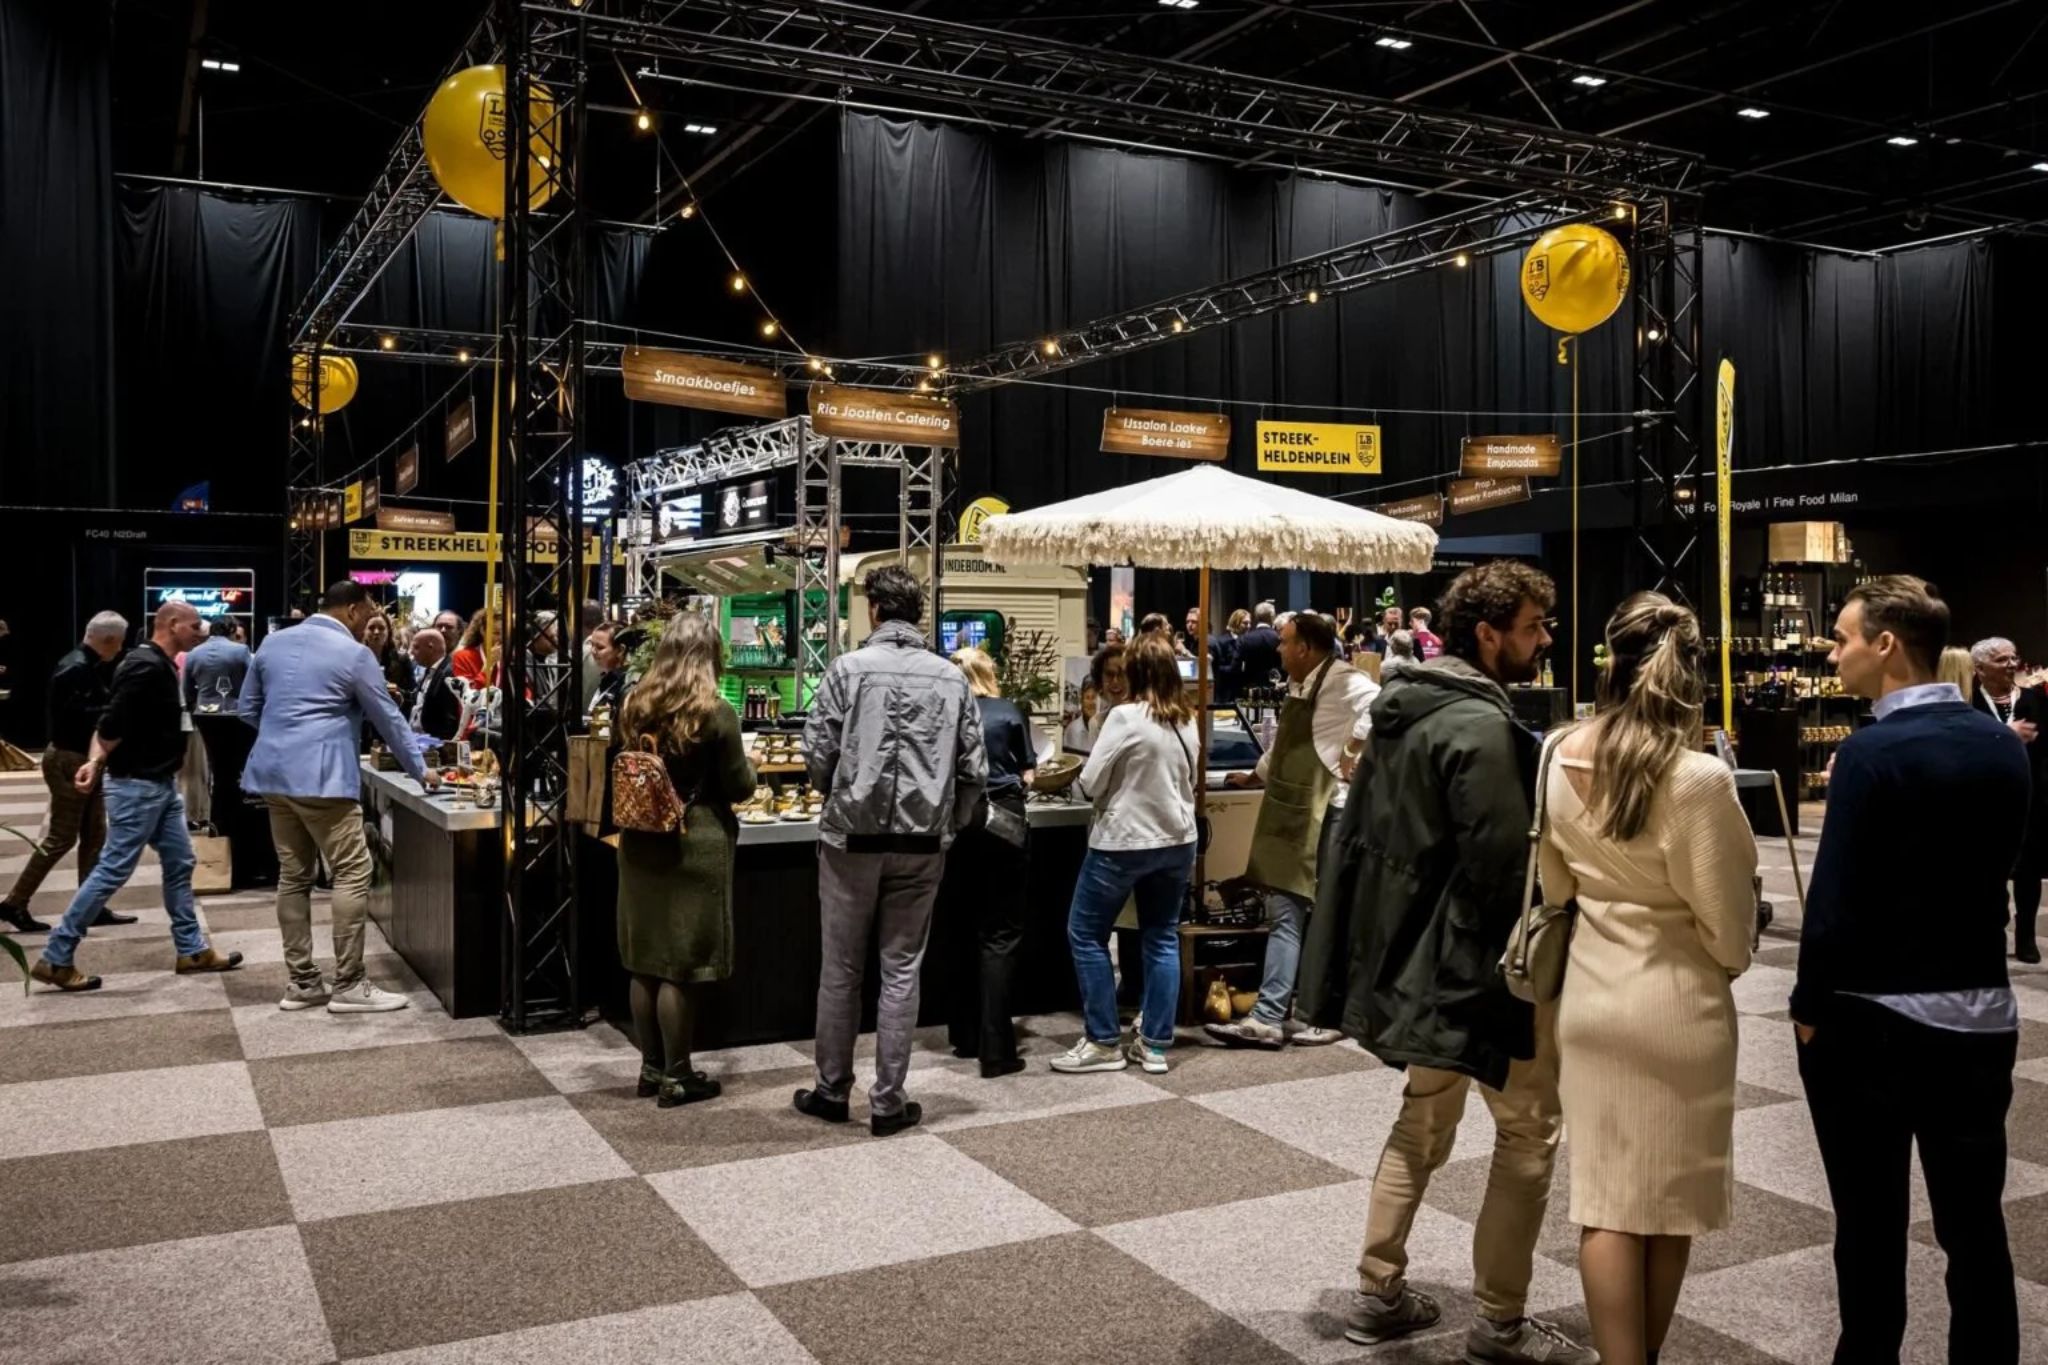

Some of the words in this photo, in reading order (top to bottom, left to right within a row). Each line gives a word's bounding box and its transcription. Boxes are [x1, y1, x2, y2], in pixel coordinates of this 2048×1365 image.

[654, 370, 756, 397] Smaakboefjes
[817, 403, 836, 416] Ria
[842, 406, 892, 422] Joosten
[896, 412, 951, 430] Catering
[1123, 418, 1167, 432] IJssalon
[1170, 419, 1207, 435] Laaker
[1141, 434, 1174, 447] Boere
[1263, 431, 1319, 446] STREEK-
[1486, 444, 1536, 454] Handmade
[1264, 452, 1350, 465] HELDENPLEIN
[1487, 458, 1539, 469] Empanadas
[1773, 496, 1795, 507] Fine
[1799, 494, 1826, 505] Food
[1830, 491, 1859, 503] Milan
[943, 559, 1006, 574] INDEBOOM.NL
